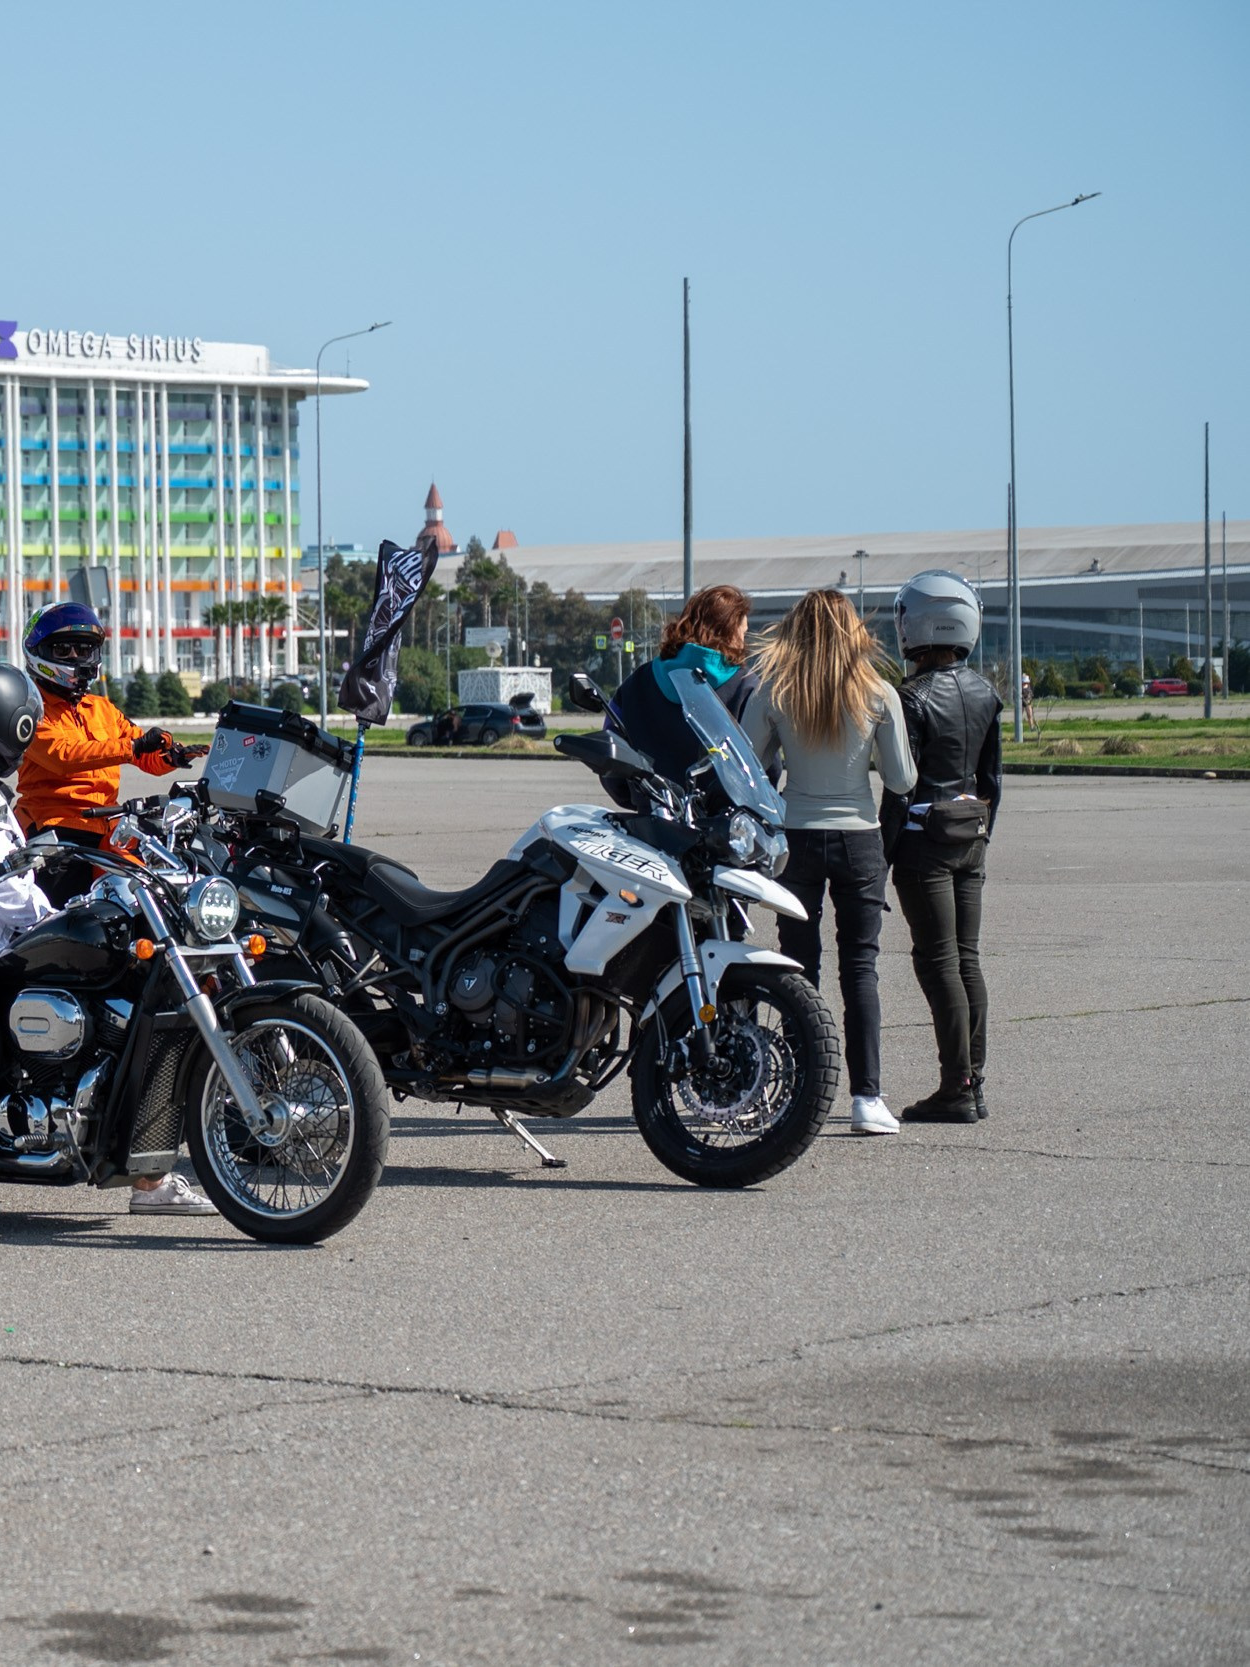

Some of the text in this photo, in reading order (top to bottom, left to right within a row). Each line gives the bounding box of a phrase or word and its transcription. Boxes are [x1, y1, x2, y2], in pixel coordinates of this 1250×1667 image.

[27, 328, 202, 363] OMEGA SIRIUS
[219, 758, 237, 768] MOTO
[566, 825, 608, 839] TRIUMPH
[577, 840, 668, 881] TIGER
